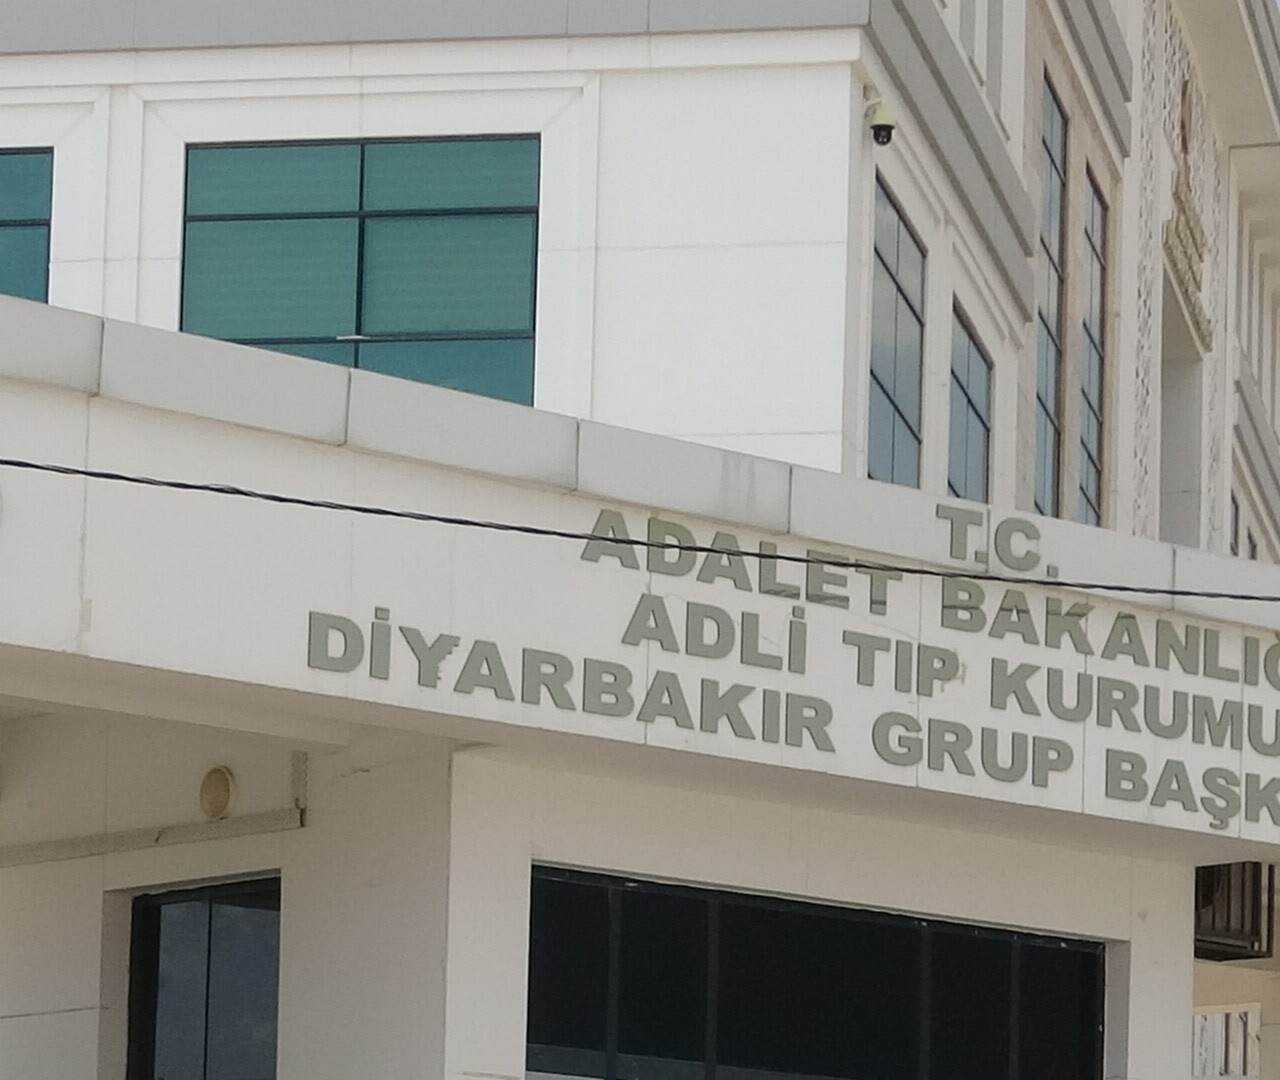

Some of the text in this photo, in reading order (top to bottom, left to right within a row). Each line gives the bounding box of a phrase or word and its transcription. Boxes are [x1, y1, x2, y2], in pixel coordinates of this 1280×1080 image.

[580, 509, 904, 616] ADALET
[935, 504, 1059, 578] T.C.
[306, 606, 836, 754] DİYARBAKIR
[871, 711, 1074, 789] GRUP
[621, 593, 808, 675] ADLİ
[842, 629, 961, 698] TIP
